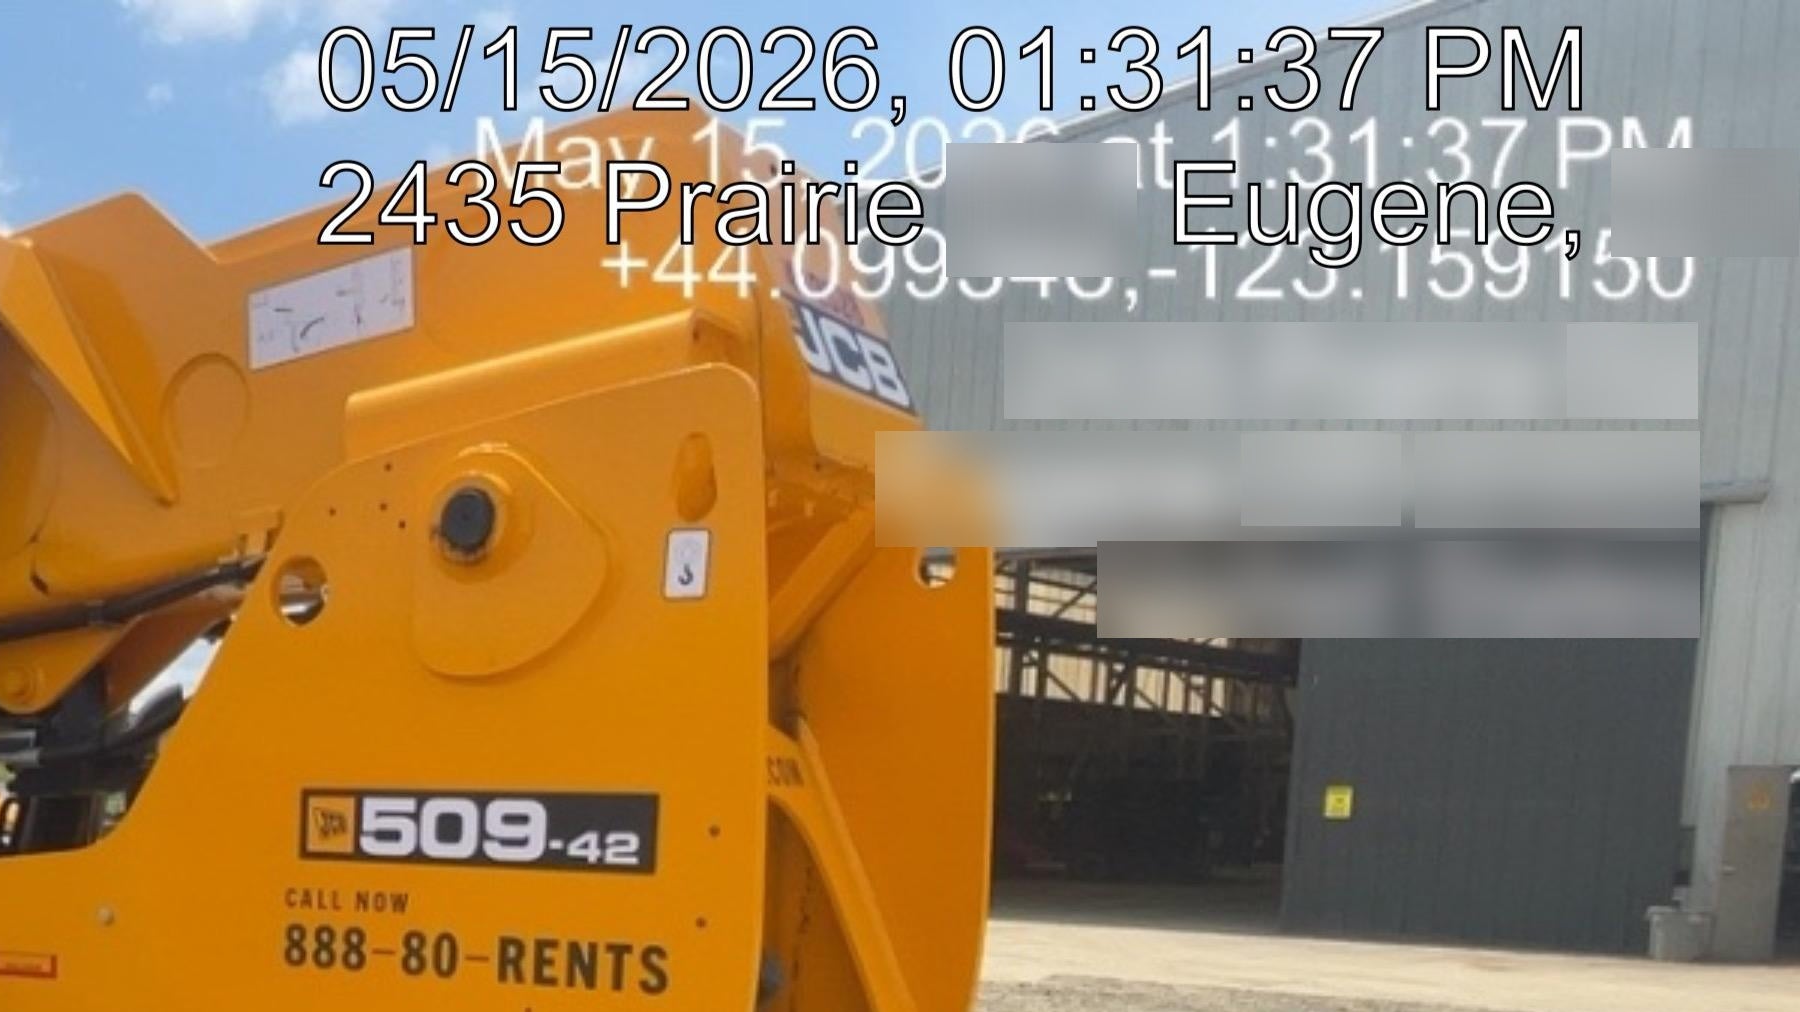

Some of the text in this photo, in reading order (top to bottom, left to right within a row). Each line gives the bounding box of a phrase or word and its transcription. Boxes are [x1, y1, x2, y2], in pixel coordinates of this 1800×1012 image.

[794, 306, 910, 407] JCB
[359, 797, 641, 864] 509-42
[283, 887, 410, 914] CALL NOW
[283, 922, 670, 995] 888-80-RENTS
